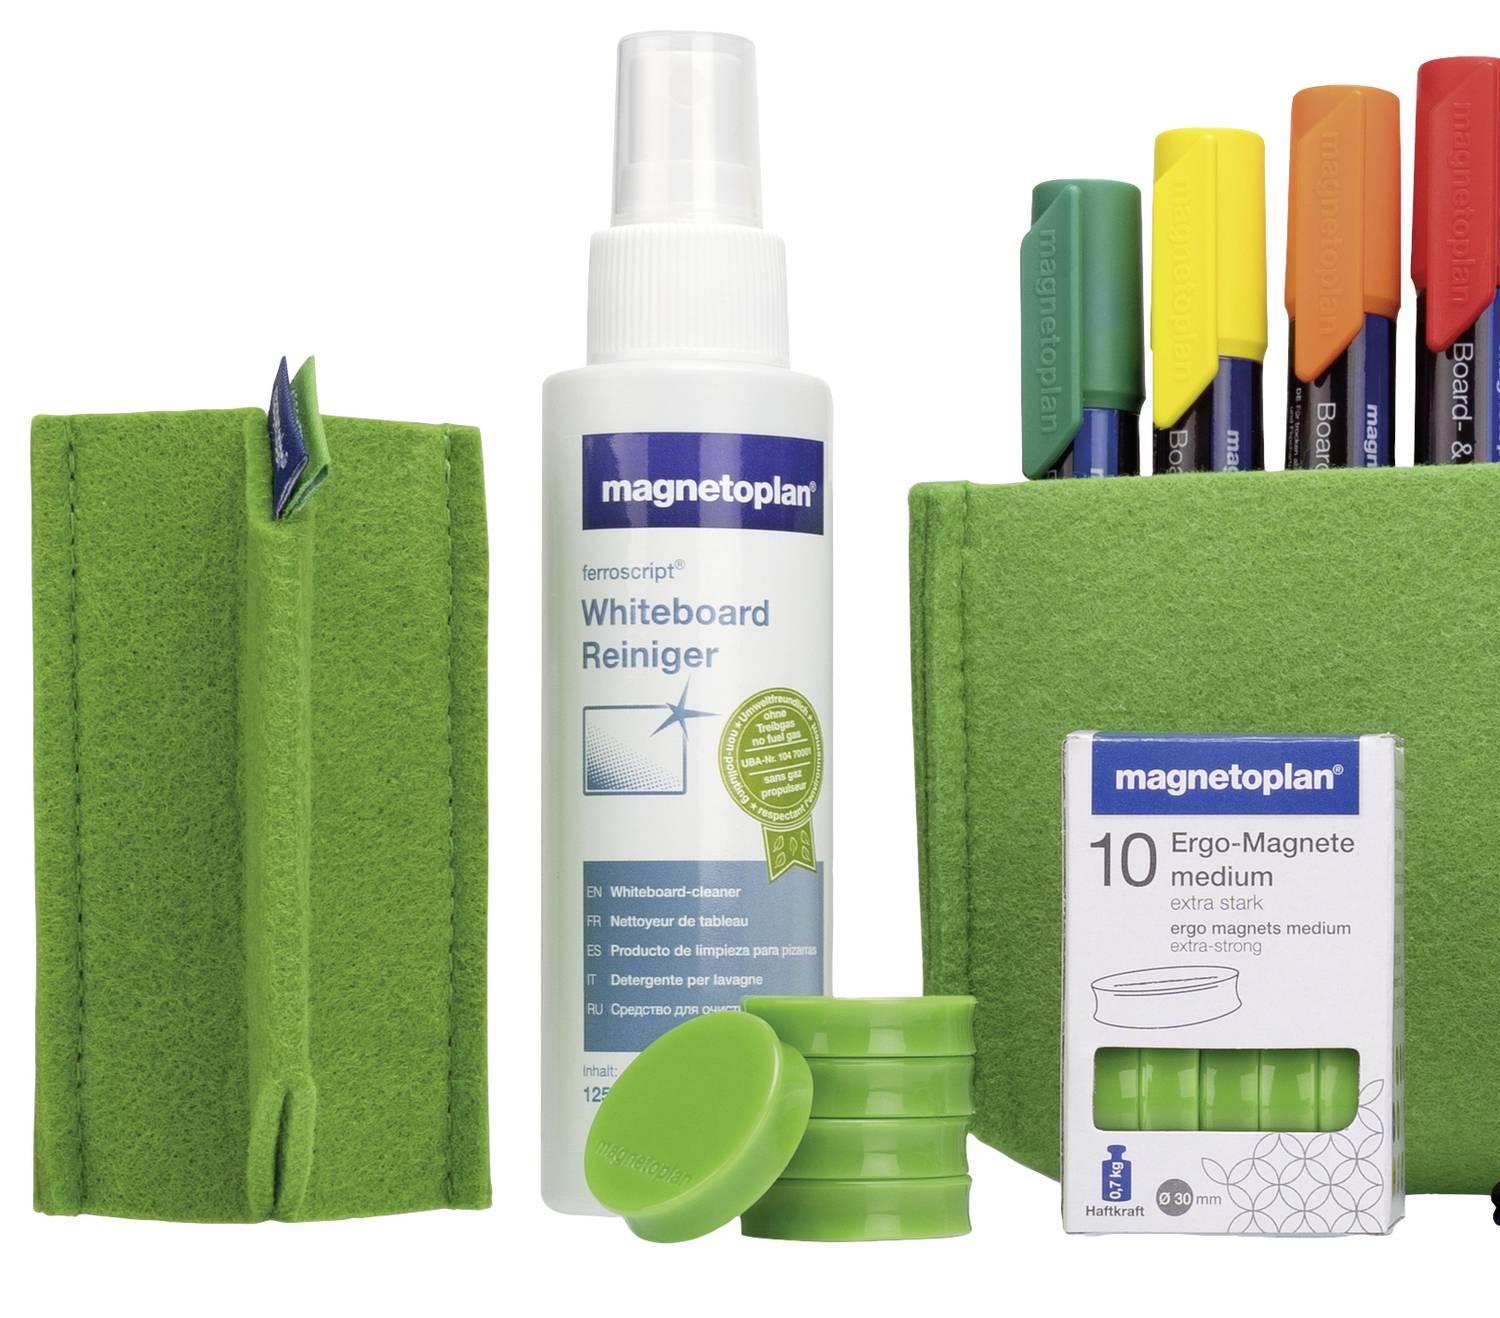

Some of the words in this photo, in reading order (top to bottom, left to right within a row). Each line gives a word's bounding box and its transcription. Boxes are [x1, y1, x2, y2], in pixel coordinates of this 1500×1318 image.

[1034, 227, 1058, 435] magnetoplan
[1452, 343, 1473, 431] Board-
[1451, 441, 1472, 459] &
[581, 598, 770, 627] Whiteboard
[582, 640, 719, 675] Reiniger
[763, 709, 787, 720] ohne
[757, 719, 796, 733] Treibgas
[752, 738, 765, 747] no
[767, 733, 785, 745] fuel
[786, 730, 801, 743] gas
[723, 729, 750, 805] non-polluting
[741, 755, 776, 768] UBA-Nr.
[764, 773, 786, 784] sans
[787, 769, 802, 781] gaz
[761, 782, 807, 800] propulseur
[757, 805, 806, 821] respectant
[1172, 832, 1355, 858] Ergo-Magnete
[1090, 832, 1157, 888] 10
[1171, 866, 1273, 887] medium
[587, 886, 602, 898] EN
[610, 885, 742, 898] Whiteboard-cleaner
[1170, 896, 1214, 911] extra
[1220, 895, 1263, 910] stark
[587, 915, 602, 927] FR
[610, 915, 675, 930] Nettoyeur
[678, 915, 696, 927] de
[700, 915, 749, 927] tableau
[1170, 923, 1206, 938] ergo
[1212, 923, 1281, 938] magnets
[1287, 921, 1351, 935] medium
[587, 944, 602, 957] ES
[610, 944, 671, 957] Producto
[674, 944, 692, 957] de
[695, 944, 750, 959] limpieza
[753, 946, 780, 959] para
[1170, 940, 1262, 955] extra-strong
[587, 974, 597, 985] IT
[610, 974, 683, 988] Detergente
[687, 976, 710, 988] per
[713, 974, 763, 988] lavagne
[587, 1003, 603, 1015] RU
[611, 1003, 672, 1018] Средство
[674, 1005, 699, 1017] для
[583, 1065, 618, 1078] Inhalt:
[1110, 1162, 1124, 1178] kg
[1110, 1181, 1123, 1199] 0,7
[1174, 1192, 1192, 1205] 30
[1196, 1196, 1221, 1205] mm
[1086, 1205, 1145, 1217] Haftkraft
